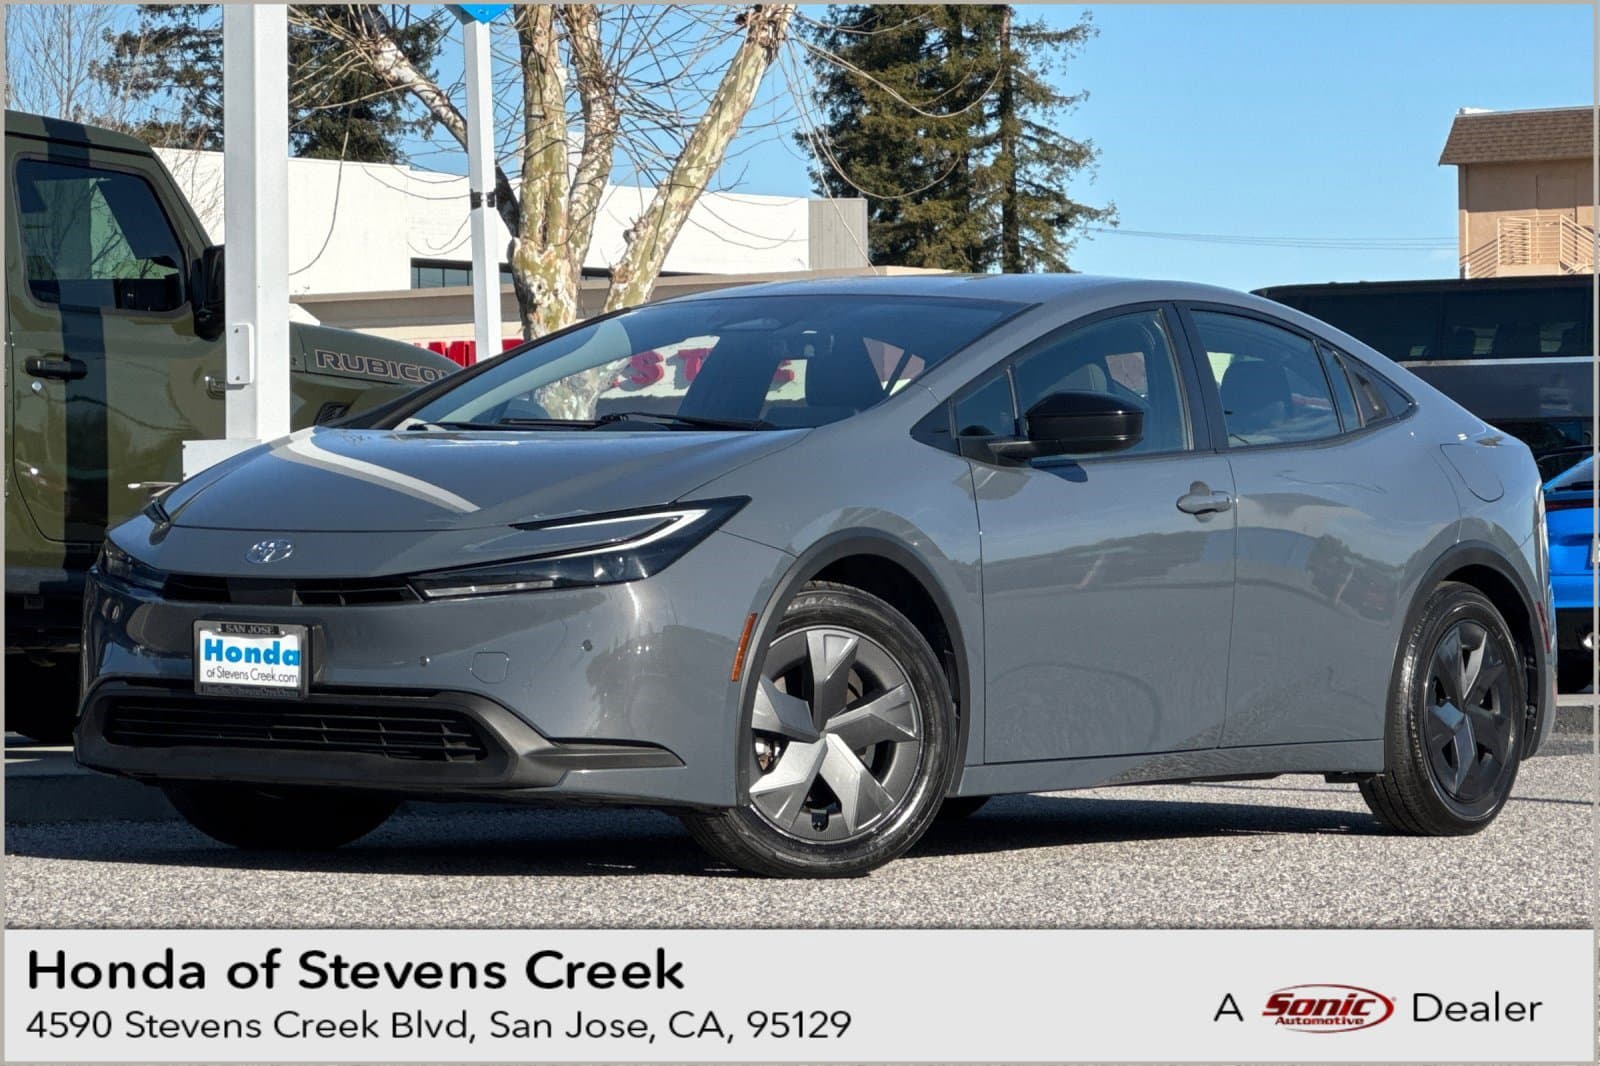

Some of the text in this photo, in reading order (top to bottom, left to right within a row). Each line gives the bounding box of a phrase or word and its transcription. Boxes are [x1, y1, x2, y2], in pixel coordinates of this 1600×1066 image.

[226, 623, 273, 634] SAN JOSE
[204, 638, 301, 666] Honda
[206, 667, 216, 679] of
[217, 666, 249, 681] Stevens
